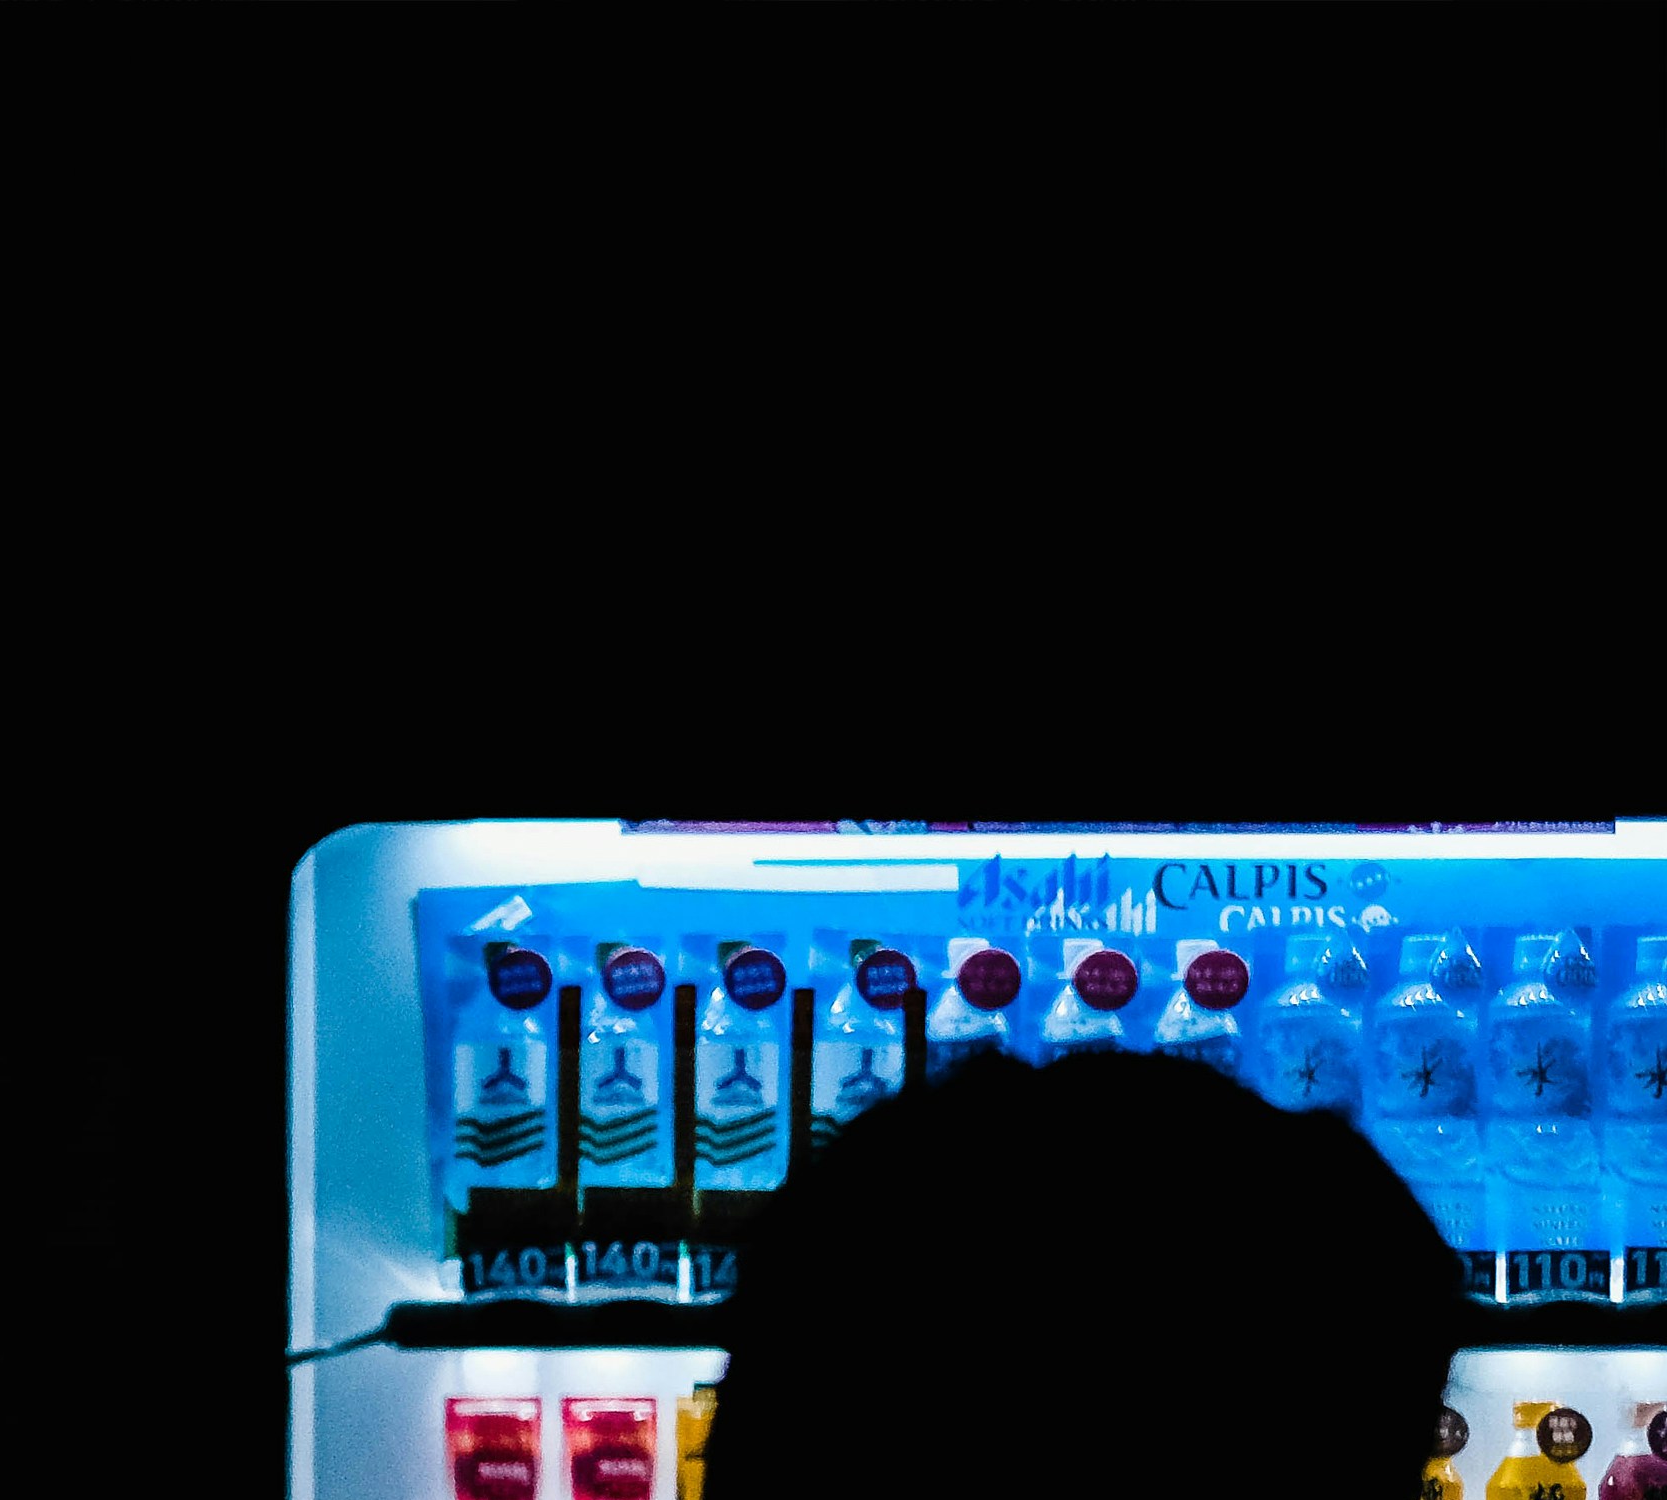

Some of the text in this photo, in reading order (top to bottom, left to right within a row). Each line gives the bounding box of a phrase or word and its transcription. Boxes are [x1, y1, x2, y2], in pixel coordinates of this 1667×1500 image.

[1152, 862, 1328, 910] CALPIS
[468, 1245, 546, 1287] 140
[581, 1239, 661, 1279] 140
[1514, 1252, 1587, 1288] 110
